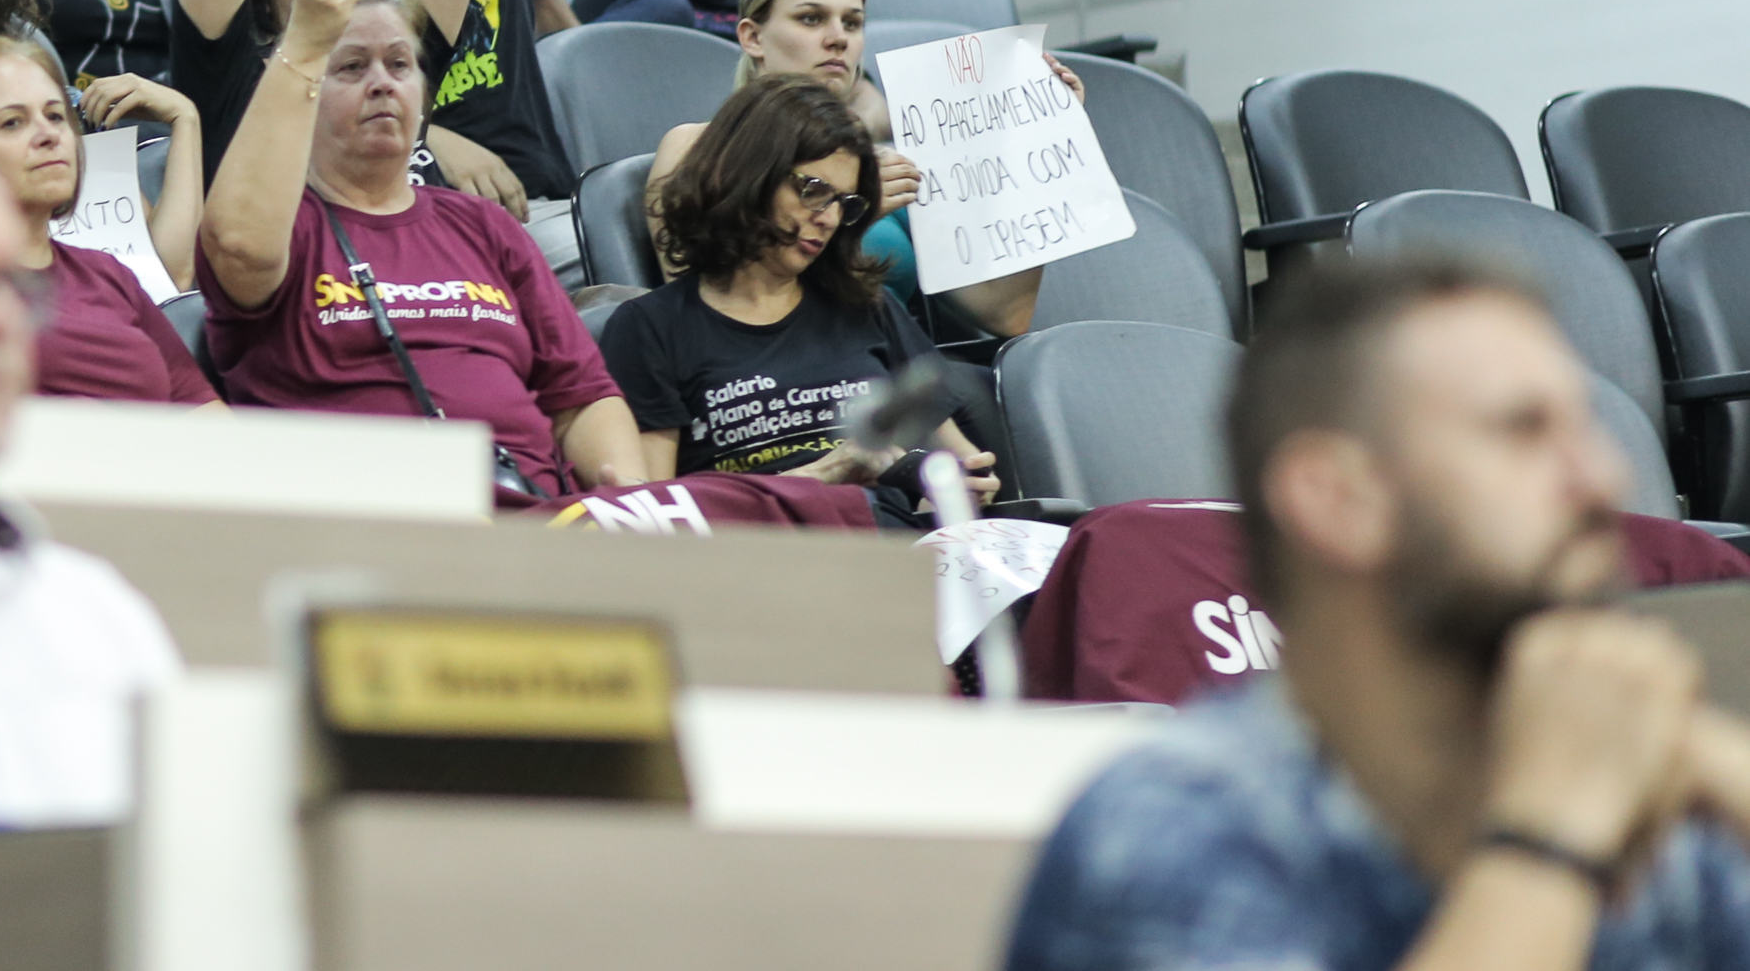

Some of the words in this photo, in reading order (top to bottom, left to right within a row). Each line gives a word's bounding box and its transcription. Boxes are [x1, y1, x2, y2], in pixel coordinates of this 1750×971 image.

[944, 35, 984, 86] NÃO
[900, 104, 925, 148] AO
[931, 73, 1071, 146] PARCELAMENTO
[950, 155, 1019, 203] DÍVIDA
[1027, 138, 1085, 184] COM
[48, 196, 134, 238] ENTO
[954, 226, 971, 265] O
[982, 201, 1086, 262] IPASEM
[384, 308, 426, 319] omos
[429, 304, 468, 318] mais
[705, 375, 777, 408] Salário
[708, 400, 763, 429] Plano
[768, 398, 787, 411] de
[787, 380, 870, 406] Carreira
[712, 409, 814, 446] Condições
[817, 409, 835, 421] de
